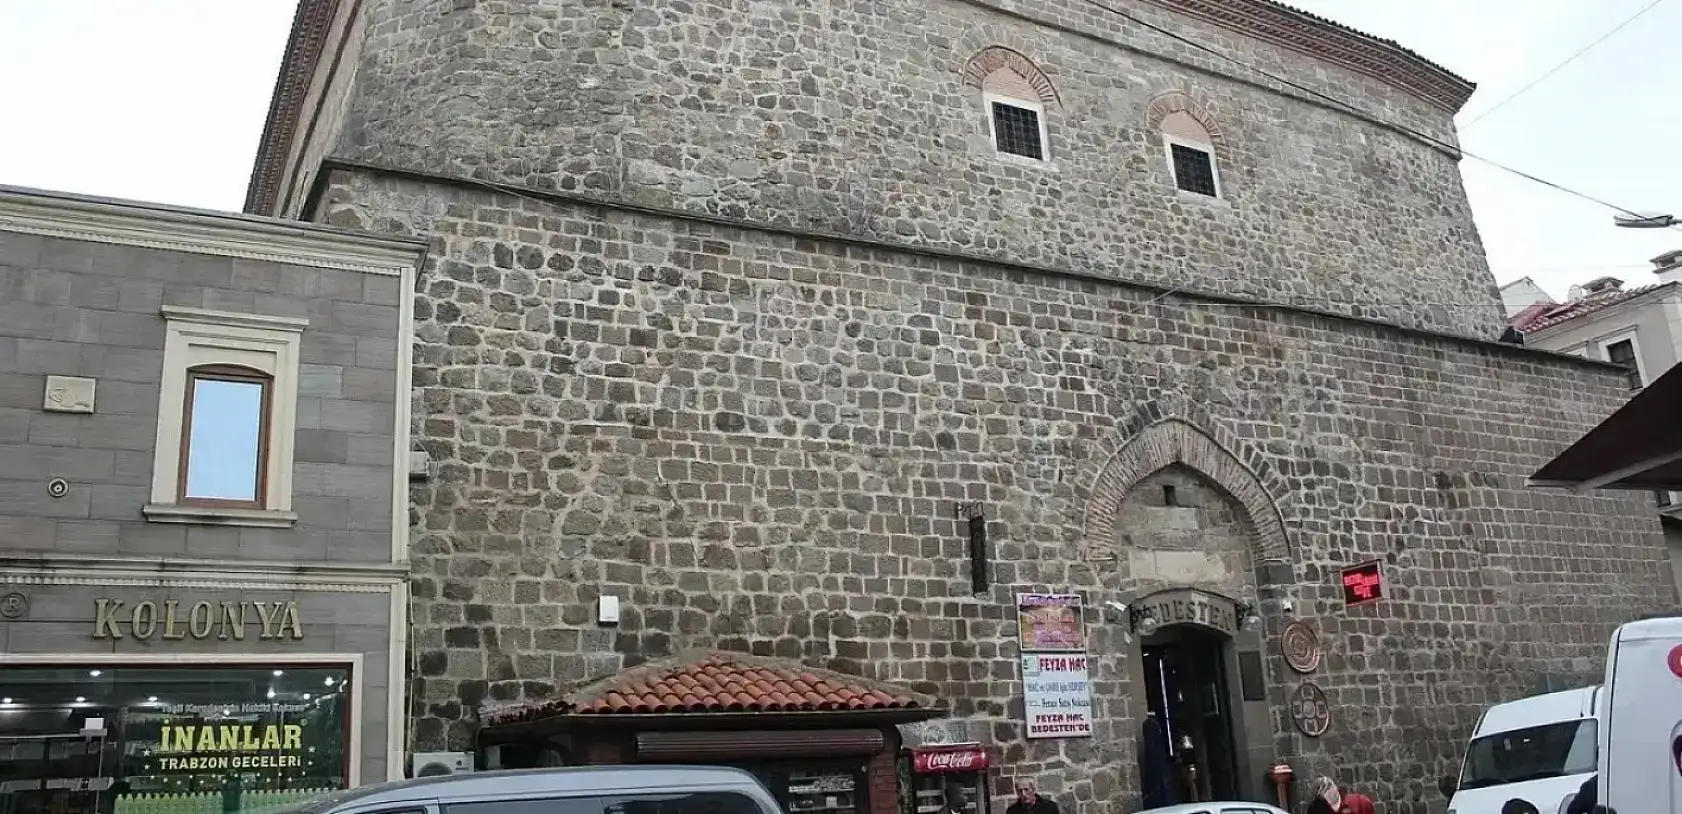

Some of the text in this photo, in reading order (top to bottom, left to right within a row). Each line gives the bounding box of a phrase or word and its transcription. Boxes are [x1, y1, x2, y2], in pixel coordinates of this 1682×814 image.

[93, 598, 303, 640] KOLONYA
[1138, 600, 1232, 630] EDESTEN
[1040, 657, 1067, 672] FEYZA
[1036, 714, 1064, 723] FEYZA
[159, 718, 302, 752] İNANLAR
[159, 755, 301, 770] TRABZON GECELERİ
